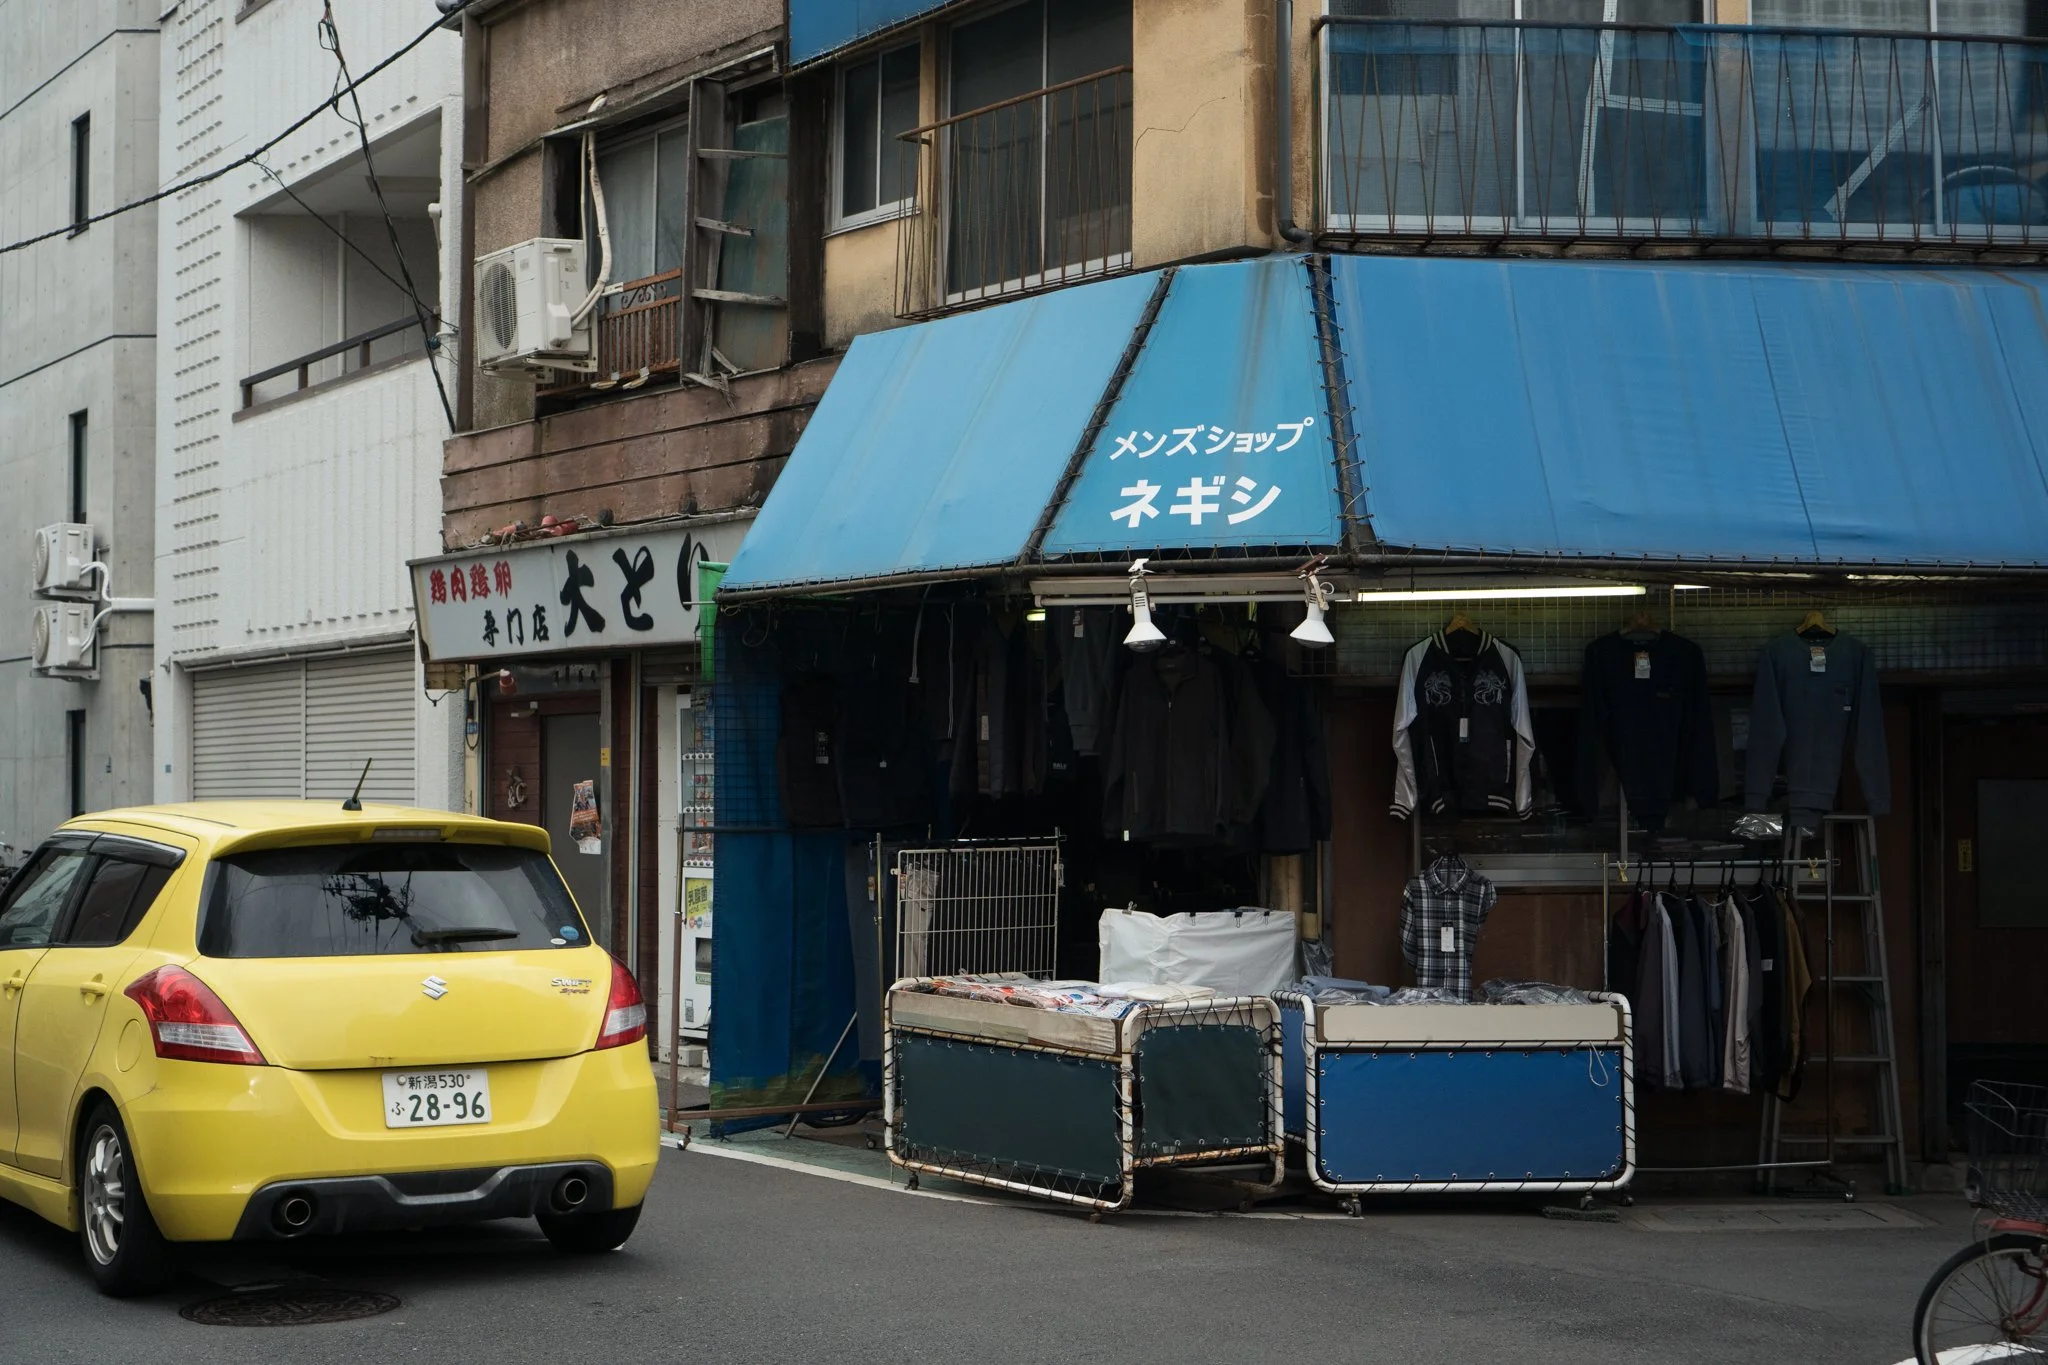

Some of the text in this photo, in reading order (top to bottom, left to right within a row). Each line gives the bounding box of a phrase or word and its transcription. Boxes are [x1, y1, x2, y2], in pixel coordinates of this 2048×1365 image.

[1109, 416, 1315, 461] メンズショップ
[1109, 475, 1282, 528] ネギシ
[551, 977, 592, 988] SWIFT
[391, 1091, 485, 1123] ふ 28-96
